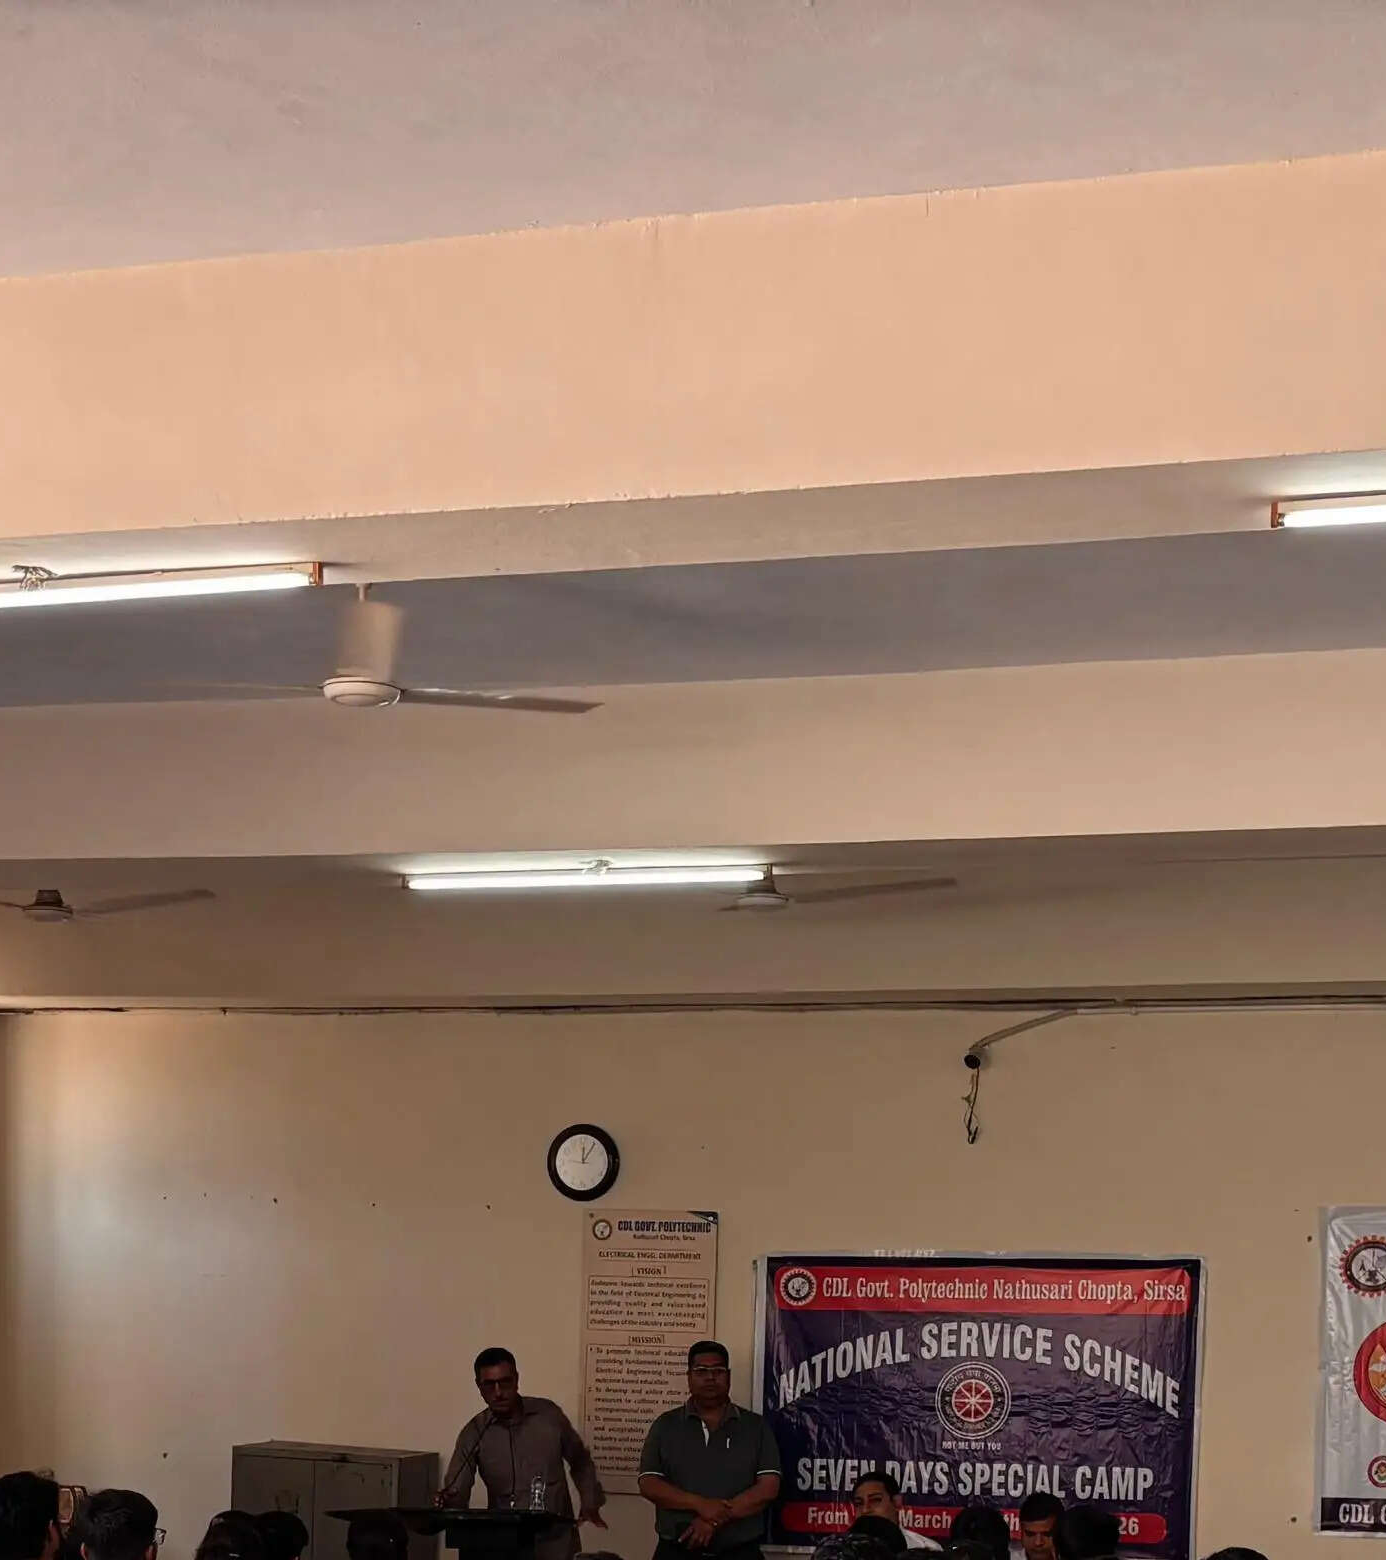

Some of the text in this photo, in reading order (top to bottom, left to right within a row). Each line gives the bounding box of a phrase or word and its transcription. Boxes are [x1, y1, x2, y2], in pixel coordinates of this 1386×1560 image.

[658, 1221, 711, 1233] POLYTECHNIC
[823, 1277, 1186, 1303] CDL Govt. Polytechnic Nathusari Chopta, Sirsa
[779, 1321, 1180, 1419] NATIONAL SERVICE SCHEME
[987, 1442, 1001, 1450] YOU
[958, 1461, 1066, 1498] SPECIAL
[1075, 1465, 1154, 1501] CAMP
[807, 1507, 850, 1525] From
[899, 1508, 952, 1529] March
[1338, 1503, 1375, 1524] CDL
